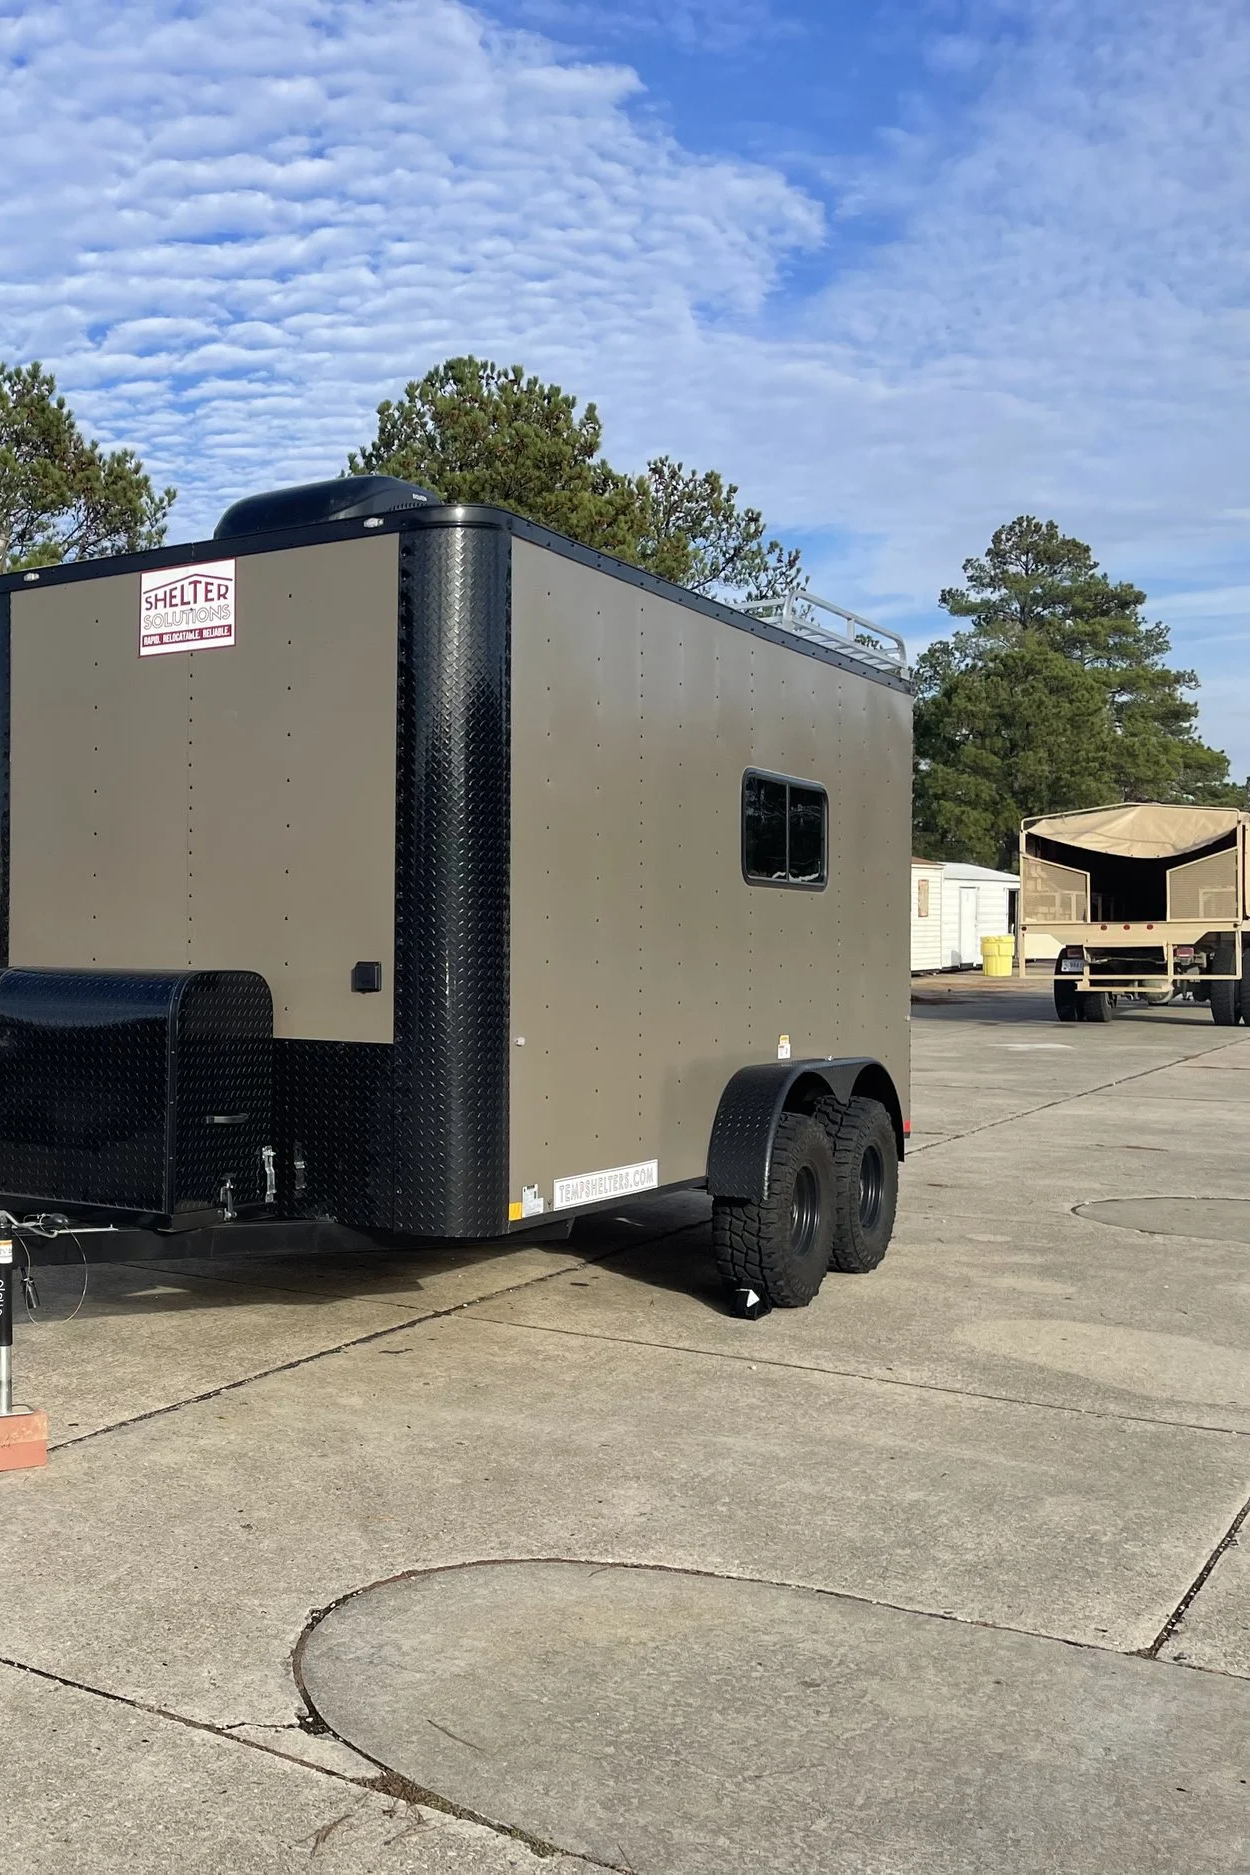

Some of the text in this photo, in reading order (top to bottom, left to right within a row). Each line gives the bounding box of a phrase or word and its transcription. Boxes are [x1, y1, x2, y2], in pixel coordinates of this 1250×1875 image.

[144, 579, 229, 611] SHELTER
[143, 604, 231, 630] SOLUTIONS
[143, 626, 230, 646] RAPID. RELOCATABLE. RELIABLE.
[558, 1166, 655, 1204] TEMPSHELTERS.COM
